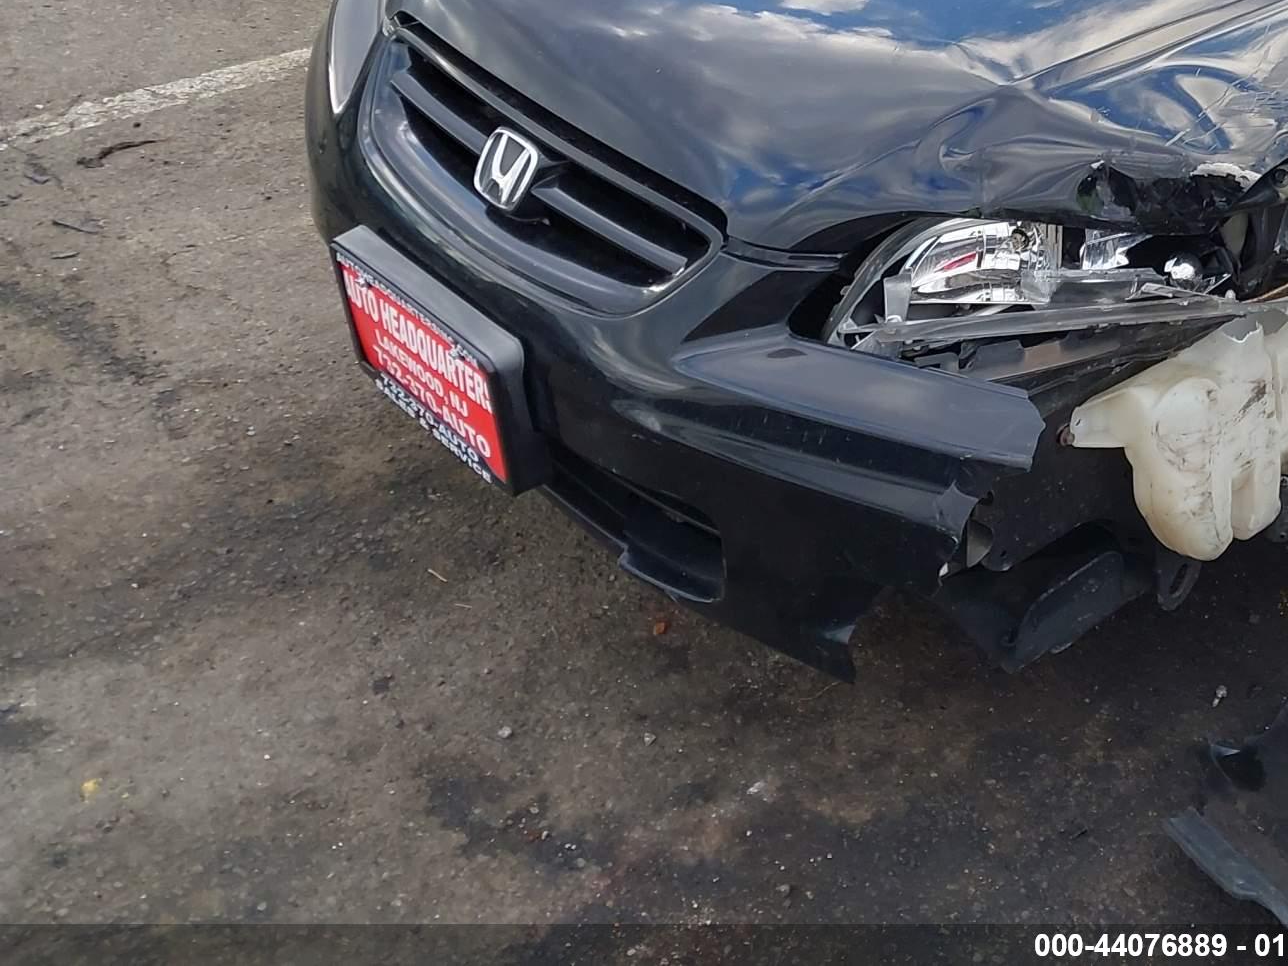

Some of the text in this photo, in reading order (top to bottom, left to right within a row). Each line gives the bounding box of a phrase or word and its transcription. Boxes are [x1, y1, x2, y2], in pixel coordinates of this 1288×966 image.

[343, 269, 380, 323] AUTO
[372, 345, 491, 458] 732-370-AUTO
[449, 390, 469, 418] NJ
[432, 428, 493, 484] SERVICE
